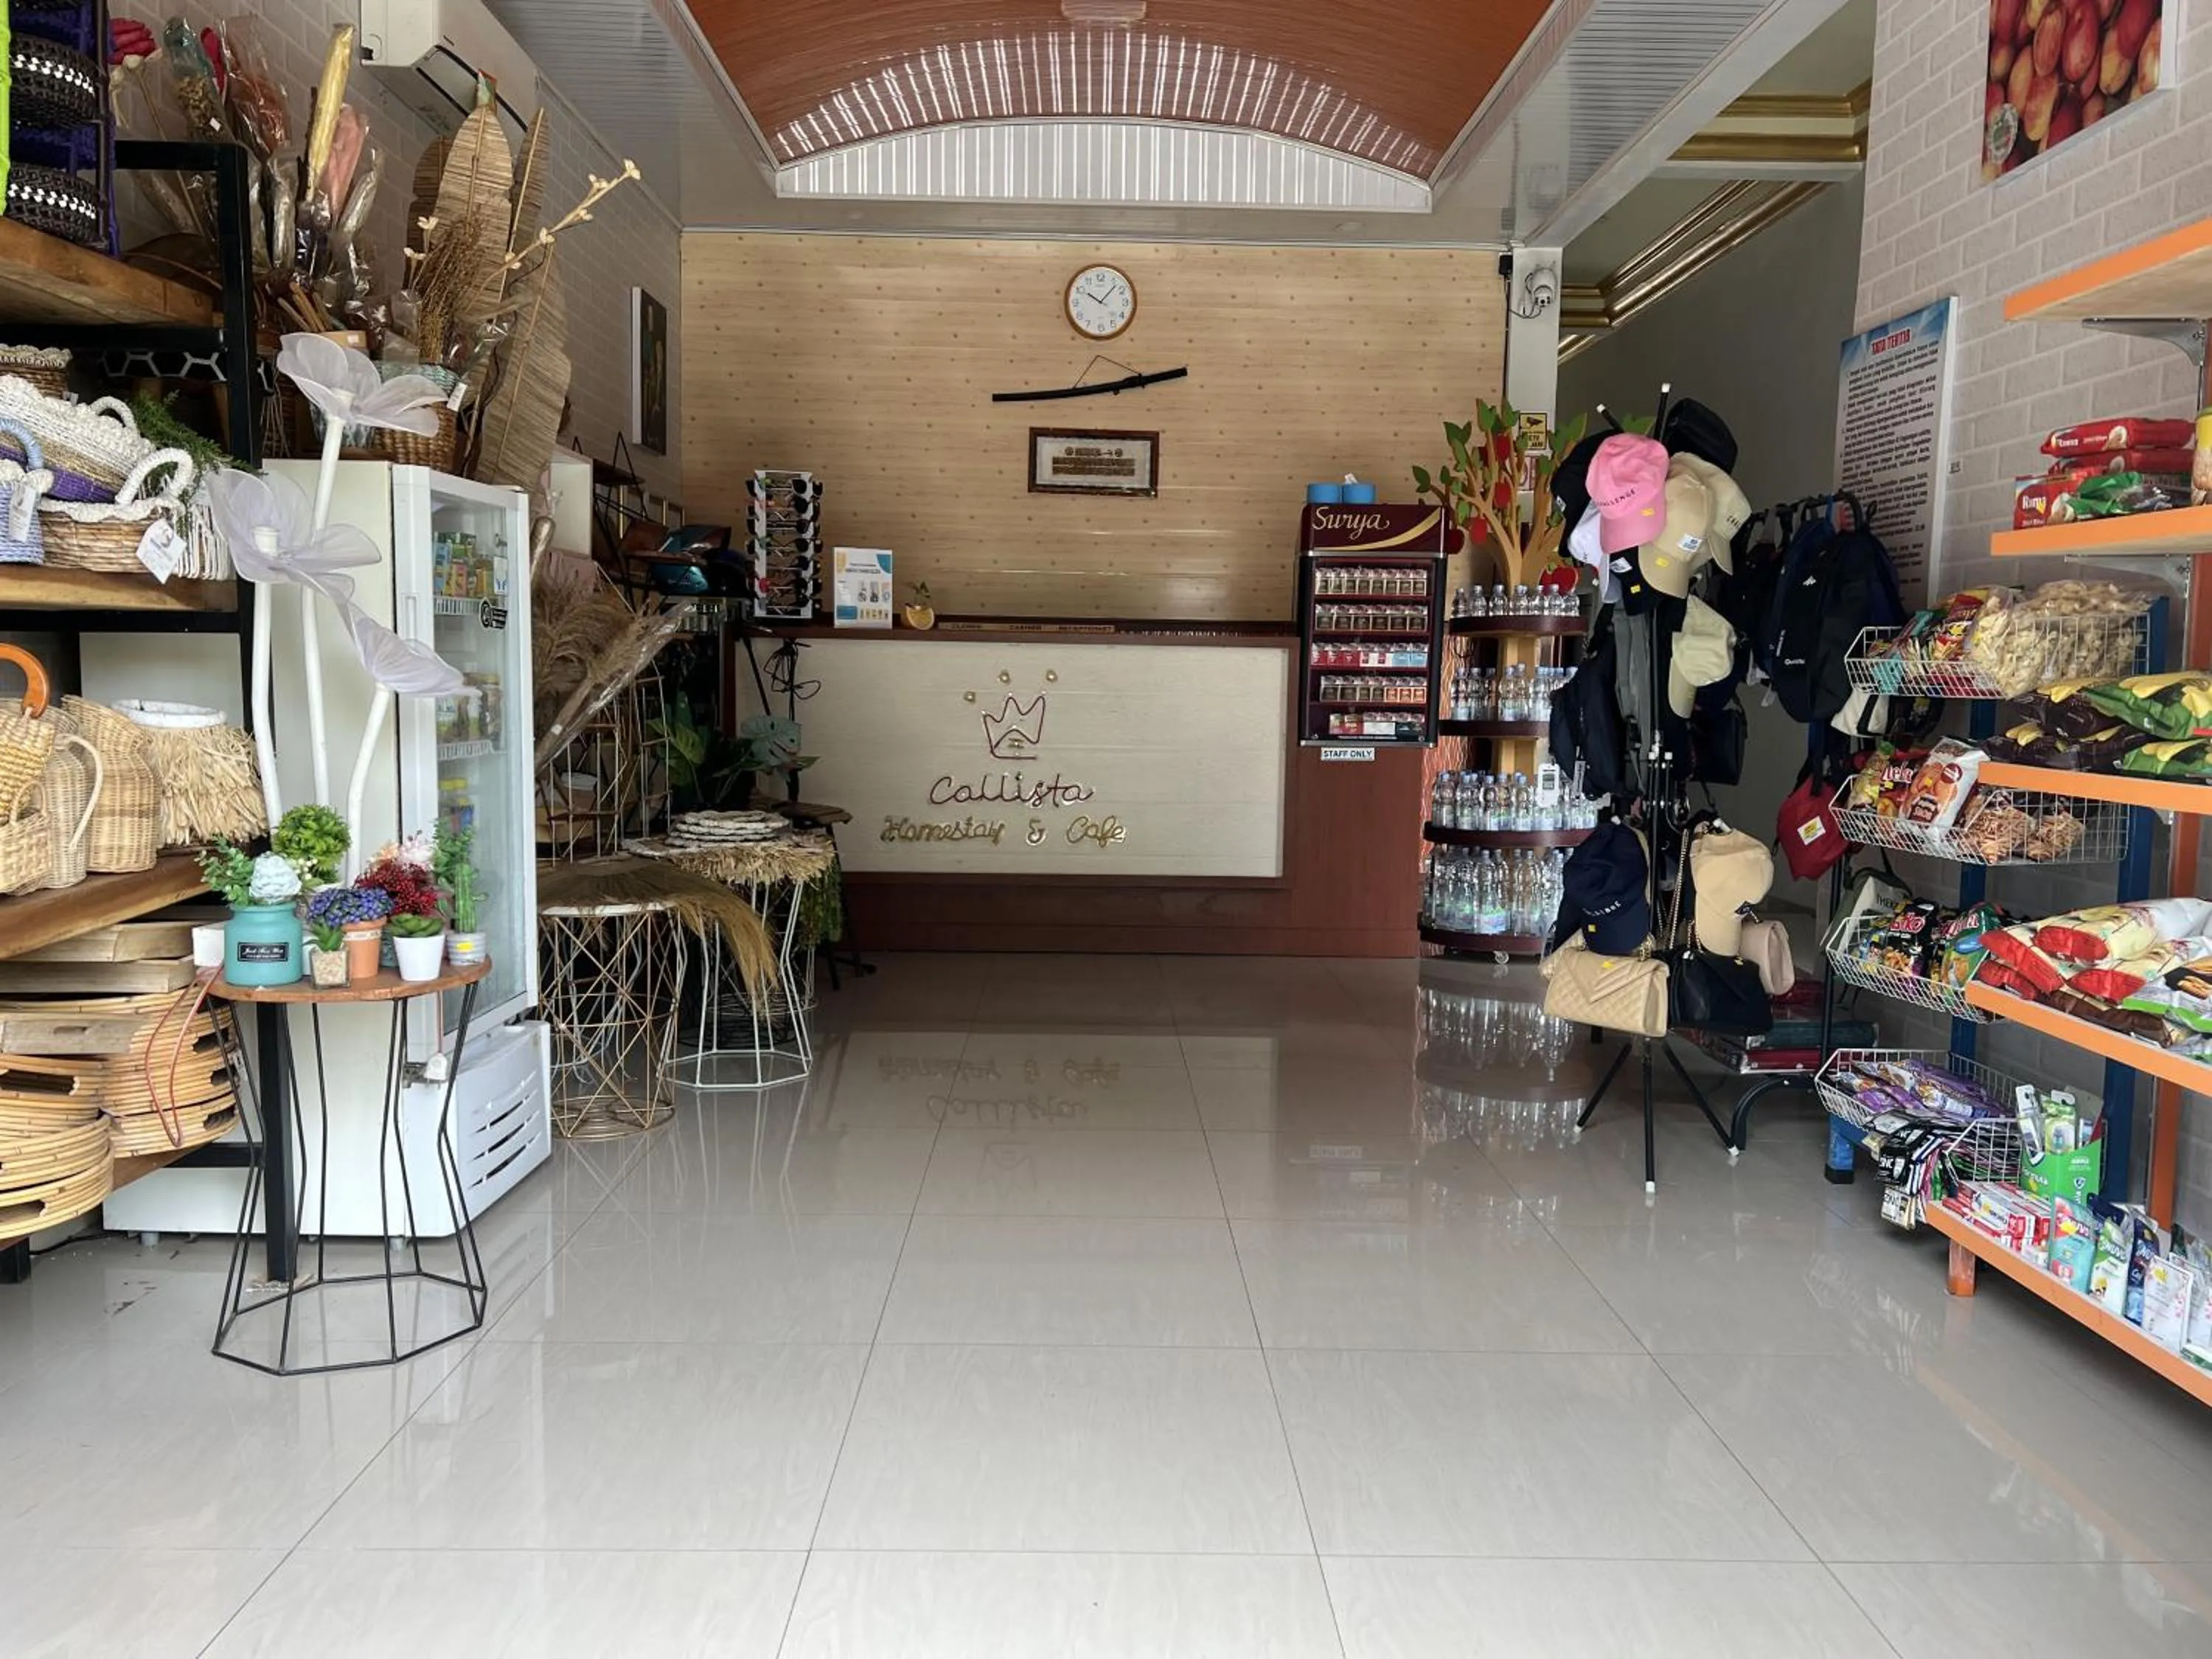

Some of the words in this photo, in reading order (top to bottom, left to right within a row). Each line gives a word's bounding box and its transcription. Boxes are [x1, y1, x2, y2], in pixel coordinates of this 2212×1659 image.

[1096, 273, 1105, 282] 12
[1312, 507, 1390, 540] Surya
[1350, 750, 1372, 758] ONLY
[929, 773, 1094, 808] Callista
[880, 815, 1005, 846] Homestay
[1066, 814, 1127, 847] Cafe
